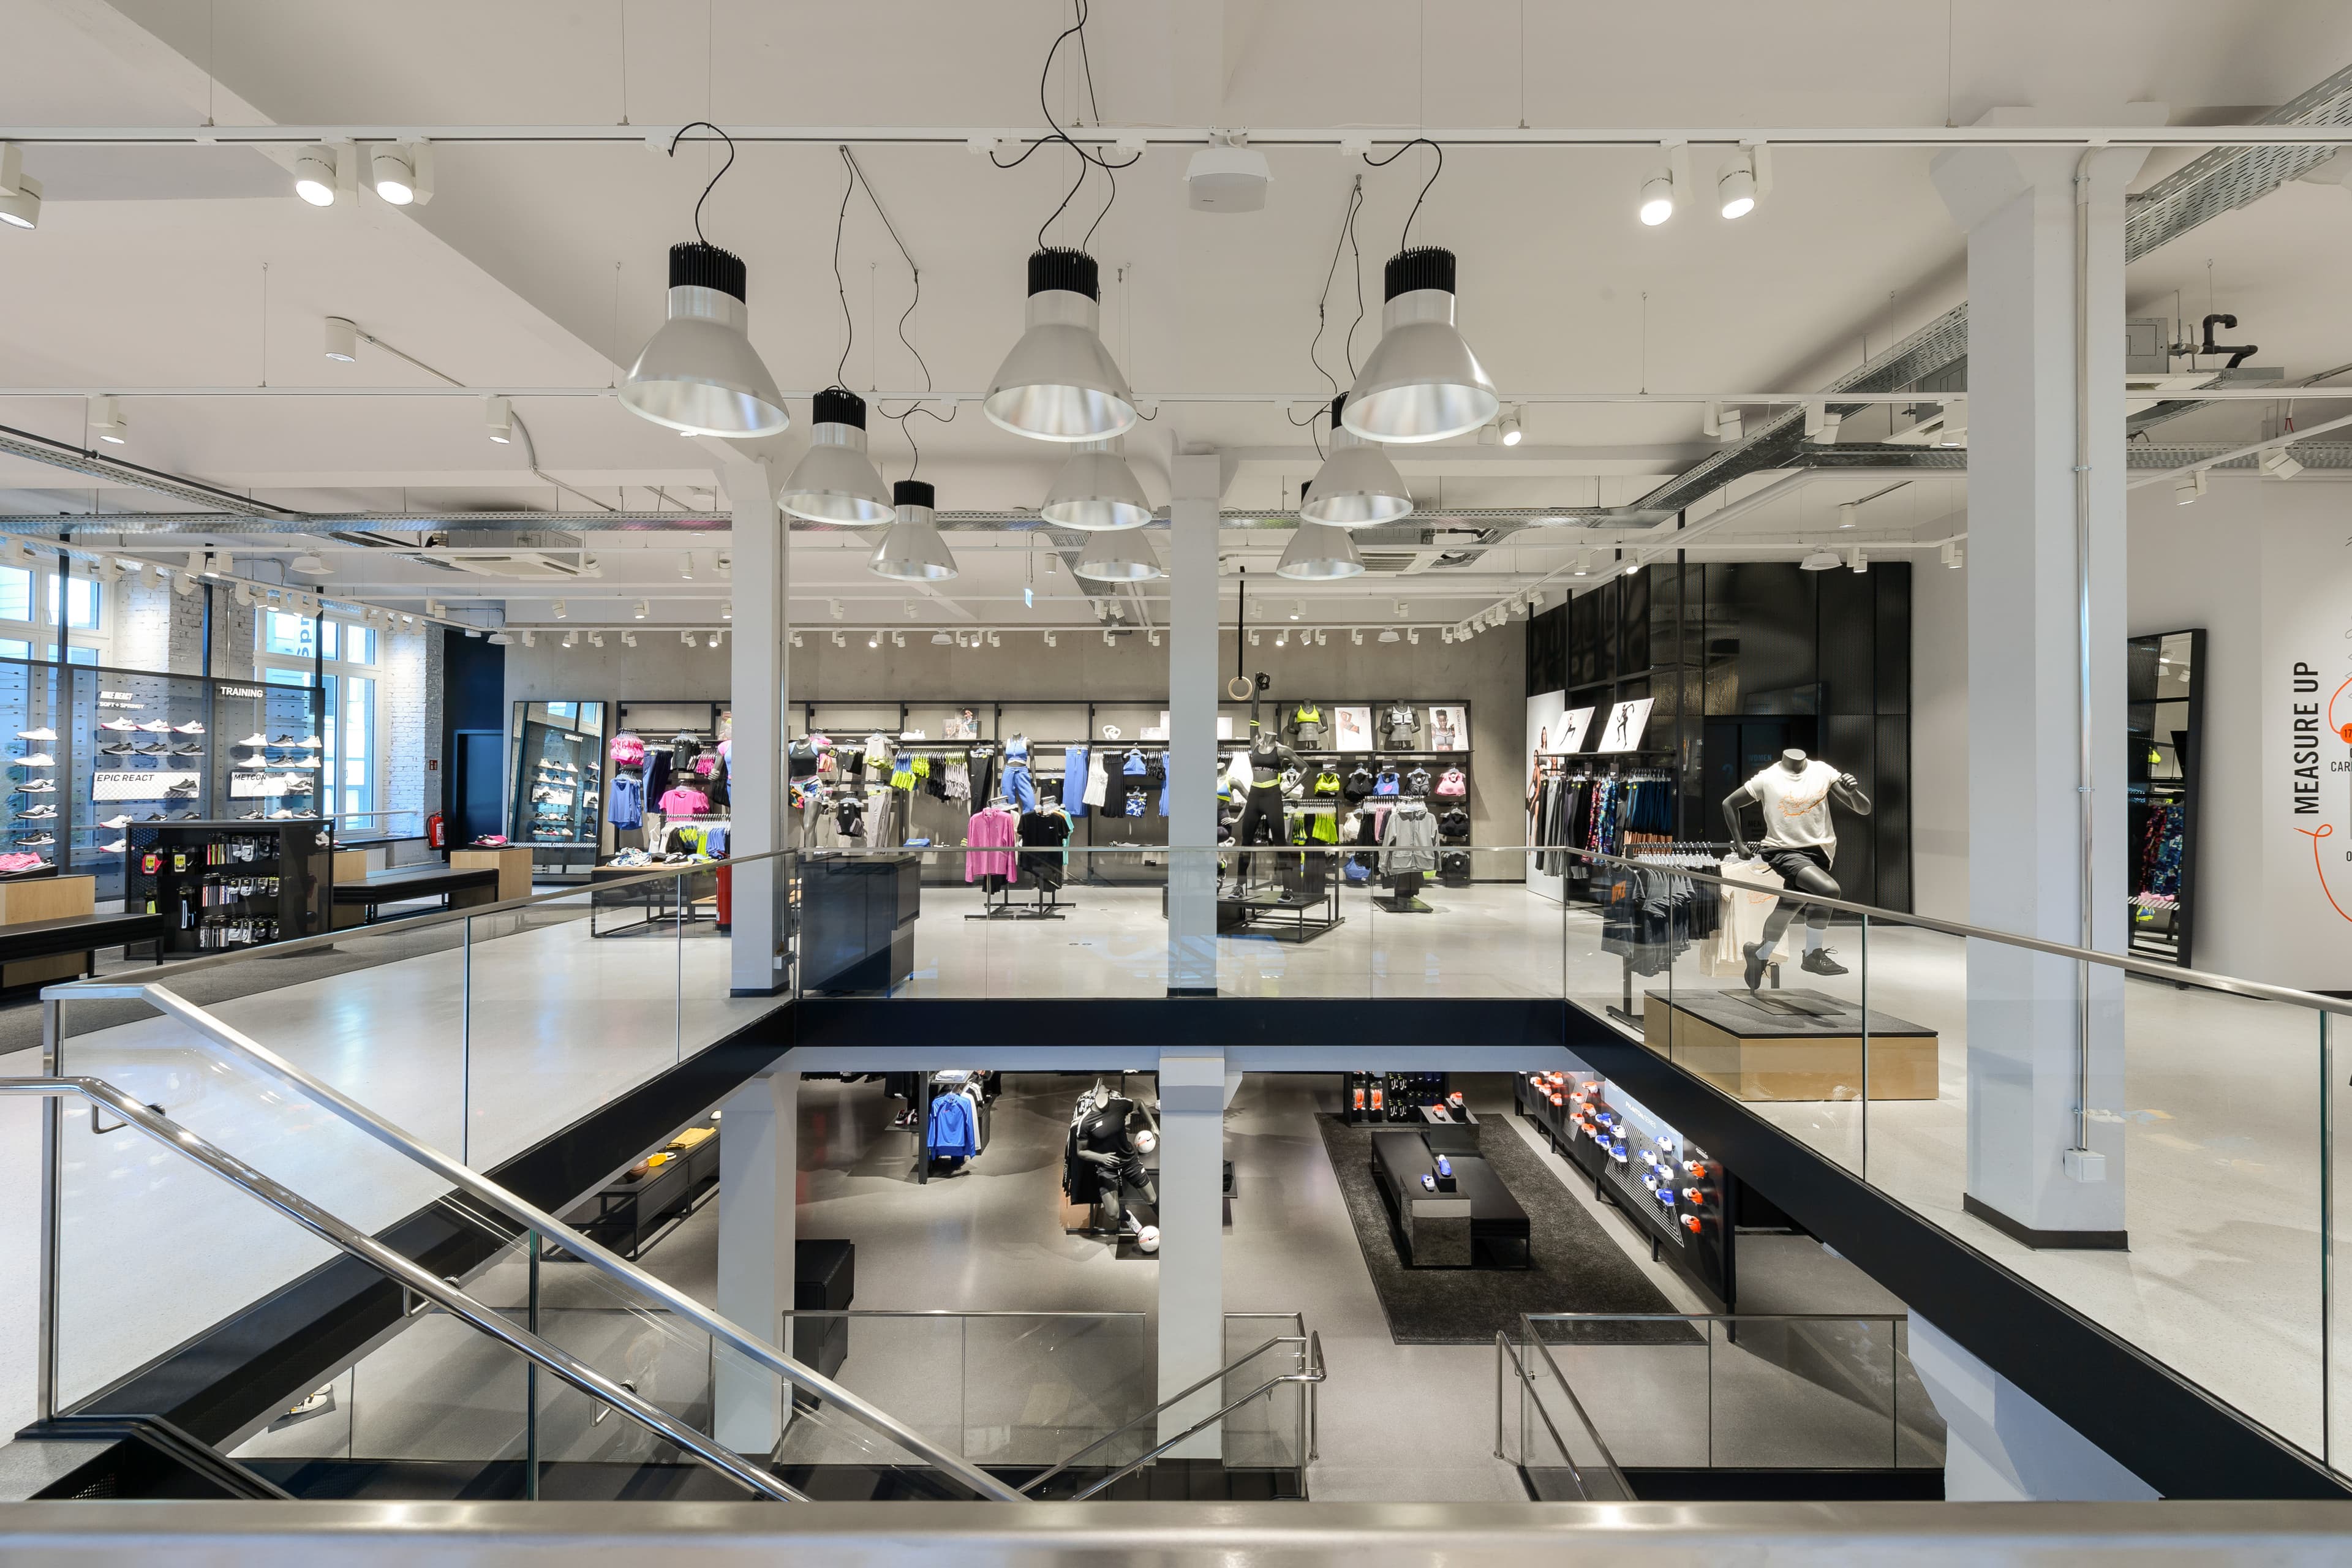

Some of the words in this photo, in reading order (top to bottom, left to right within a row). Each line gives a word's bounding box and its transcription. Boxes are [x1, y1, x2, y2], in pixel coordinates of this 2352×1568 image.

[2293, 662, 2319, 693] UP
[220, 687, 263, 698] TRAINING
[2293, 703, 2320, 814] MEASURE
[2331, 761, 2352, 772] CAR
[97, 774, 121, 782] EPIC
[122, 774, 155, 782] REACT
